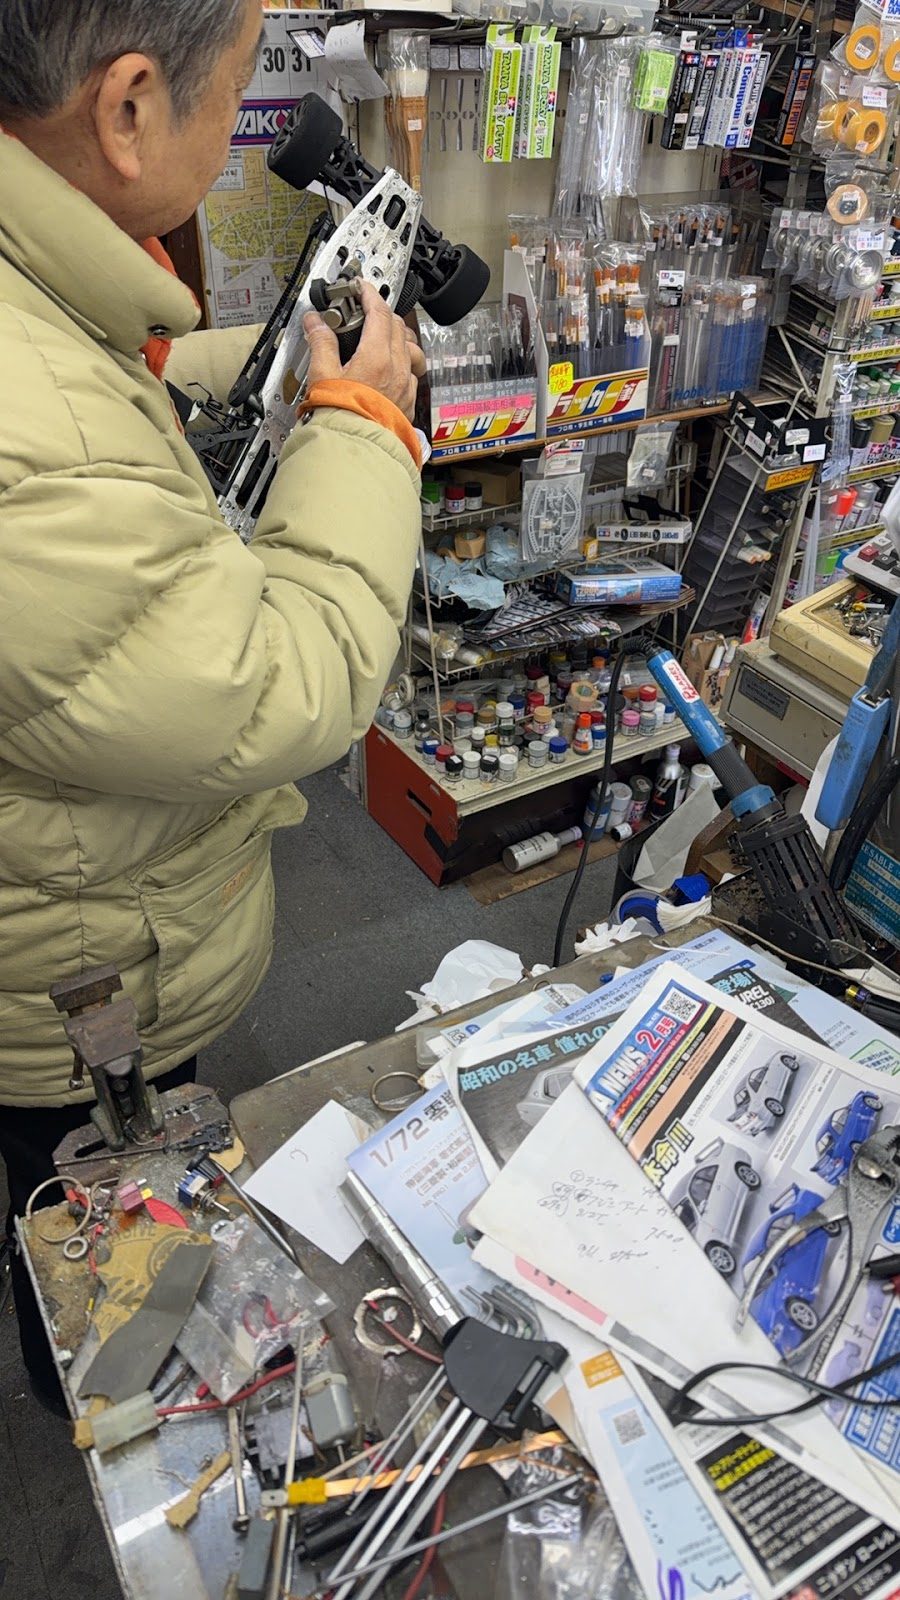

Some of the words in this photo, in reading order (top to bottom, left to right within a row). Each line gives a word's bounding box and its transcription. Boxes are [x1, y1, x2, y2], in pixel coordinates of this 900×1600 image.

[262, 47, 285, 73] 30
[292, 47, 311, 72] 31
[459, 1042, 556, 1093] 昭和の名車
[554, 1019, 622, 1056] 憧れの
[602, 1045, 647, 1096] NEWS
[369, 1116, 430, 1169] 1/72
